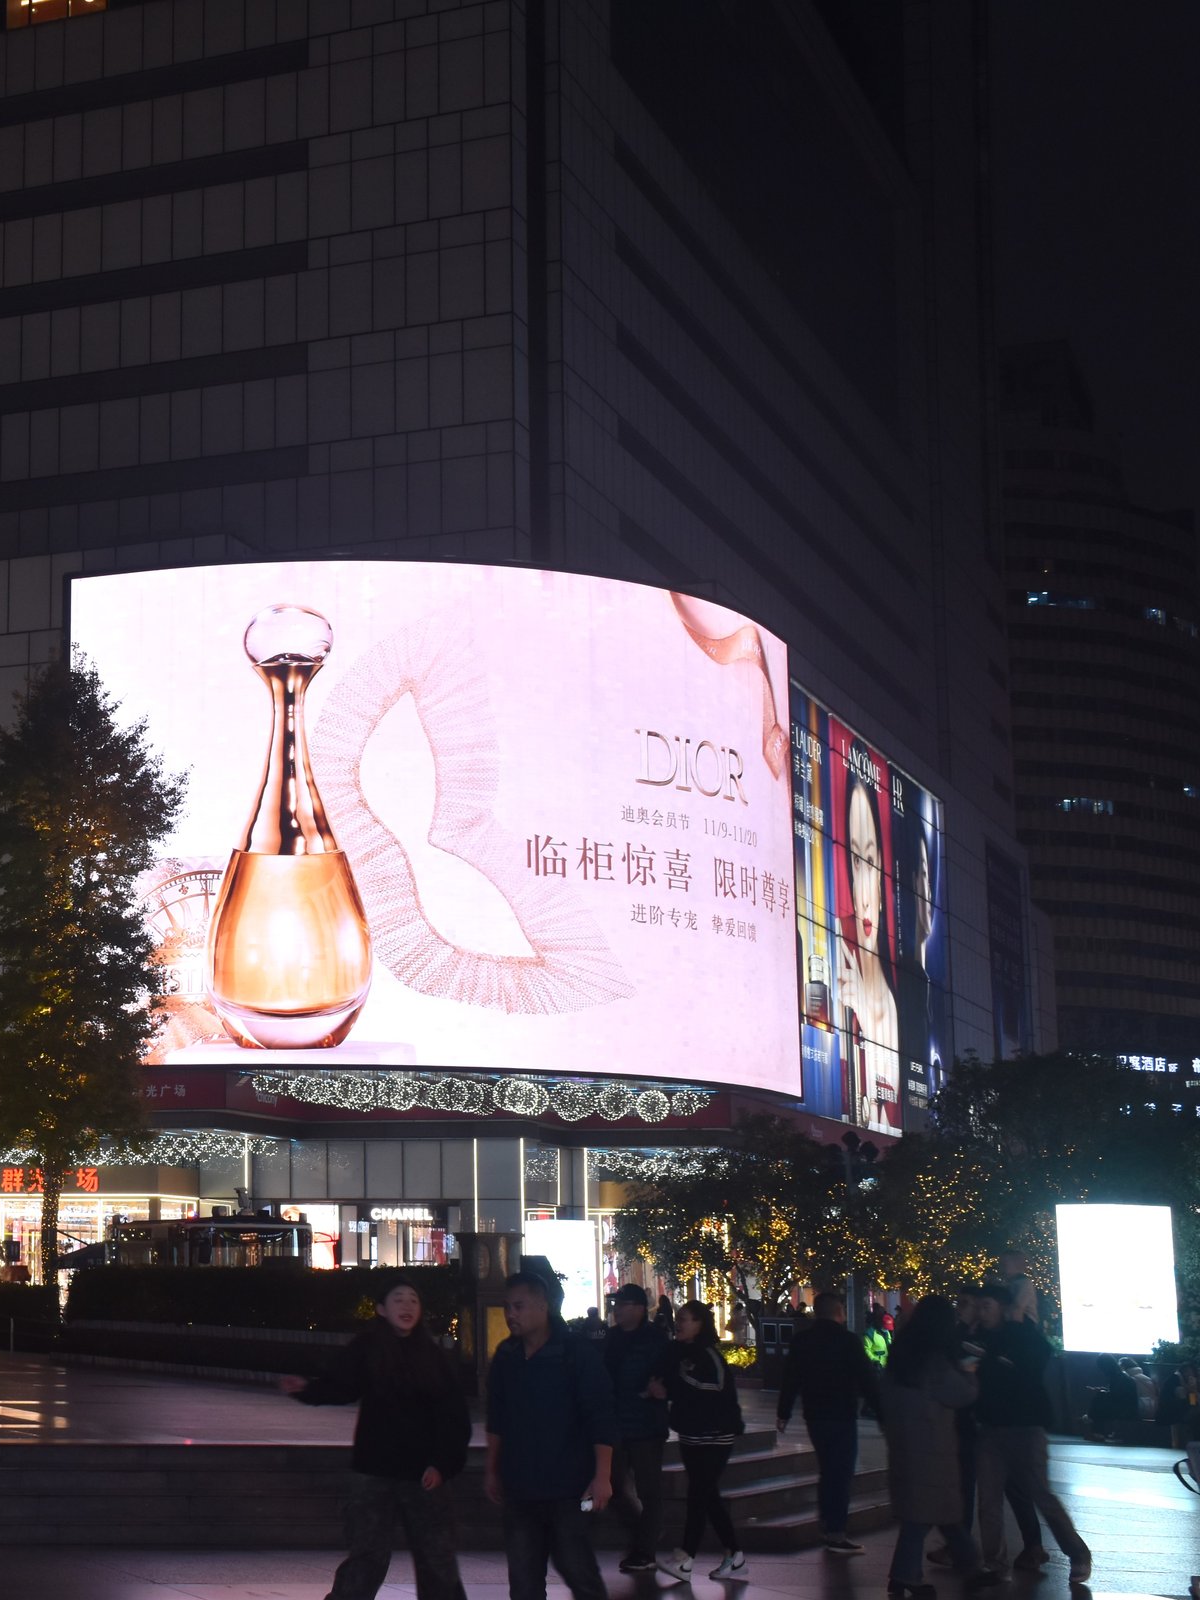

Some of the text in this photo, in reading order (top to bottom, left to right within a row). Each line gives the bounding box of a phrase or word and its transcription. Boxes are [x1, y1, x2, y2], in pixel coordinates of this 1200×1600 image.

[634, 728, 749, 807] DIOR
[621, 805, 758, 848] 迪奥会员节 11/9-11/20
[526, 834, 790, 920] 临柜惊喜 限时尊享
[630, 903, 758, 943] 进阶专宠 挚爱回馈
[130, 1084, 186, 1098] 光广场
[1, 1167, 99, 1193] 群光场
[370, 1207, 434, 1221] CHANEL
